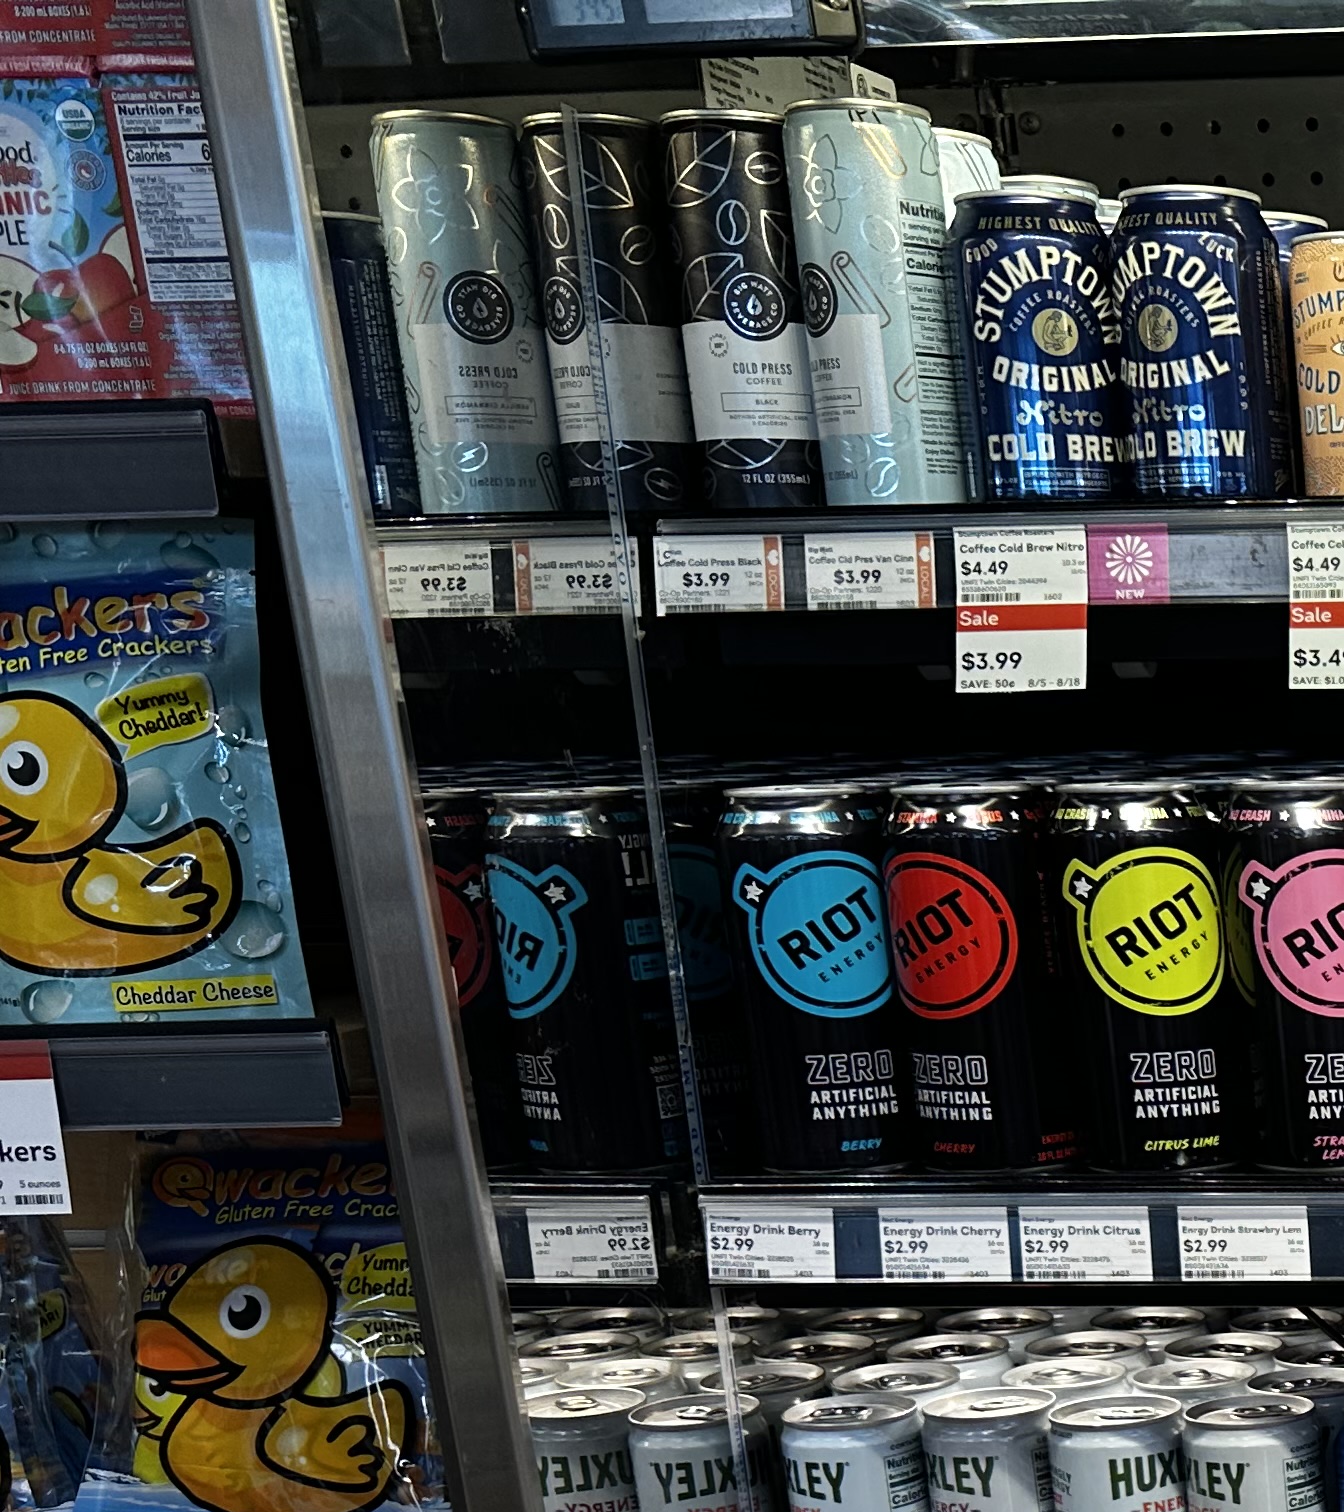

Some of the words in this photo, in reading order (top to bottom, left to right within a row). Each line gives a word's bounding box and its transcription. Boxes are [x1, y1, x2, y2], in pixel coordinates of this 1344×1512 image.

[733, 362, 761, 375] COLD
[764, 361, 793, 375] PRESS
[992, 356, 1116, 393] ORIGINAL
[960, 543, 994, 553] Coffee
[998, 543, 1023, 553] Cold
[1026, 543, 1053, 553] Brew
[1057, 543, 1084, 552] Nitro
[960, 560, 1008, 576] $4.49
[1115, 590, 1145, 600] NEW
[959, 610, 999, 628] Sale
[962, 651, 1023, 672] $3.99
[114, 688, 189, 714] Yummy
[117, 706, 206, 740] Cheddar!
[1105, 883, 1204, 967] RIOT
[1145, 932, 1209, 980] ENERGY
[115, 984, 198, 1006] Cheddar
[202, 981, 275, 1003] Cheese
[1130, 1049, 1216, 1083] ZERO
[1134, 1084, 1218, 1103] ARTIFICIAL
[1136, 1101, 1220, 1119] ANYTHING
[1144, 1137, 1189, 1152] CITRUS
[1192, 1135, 1220, 1149] LIME
